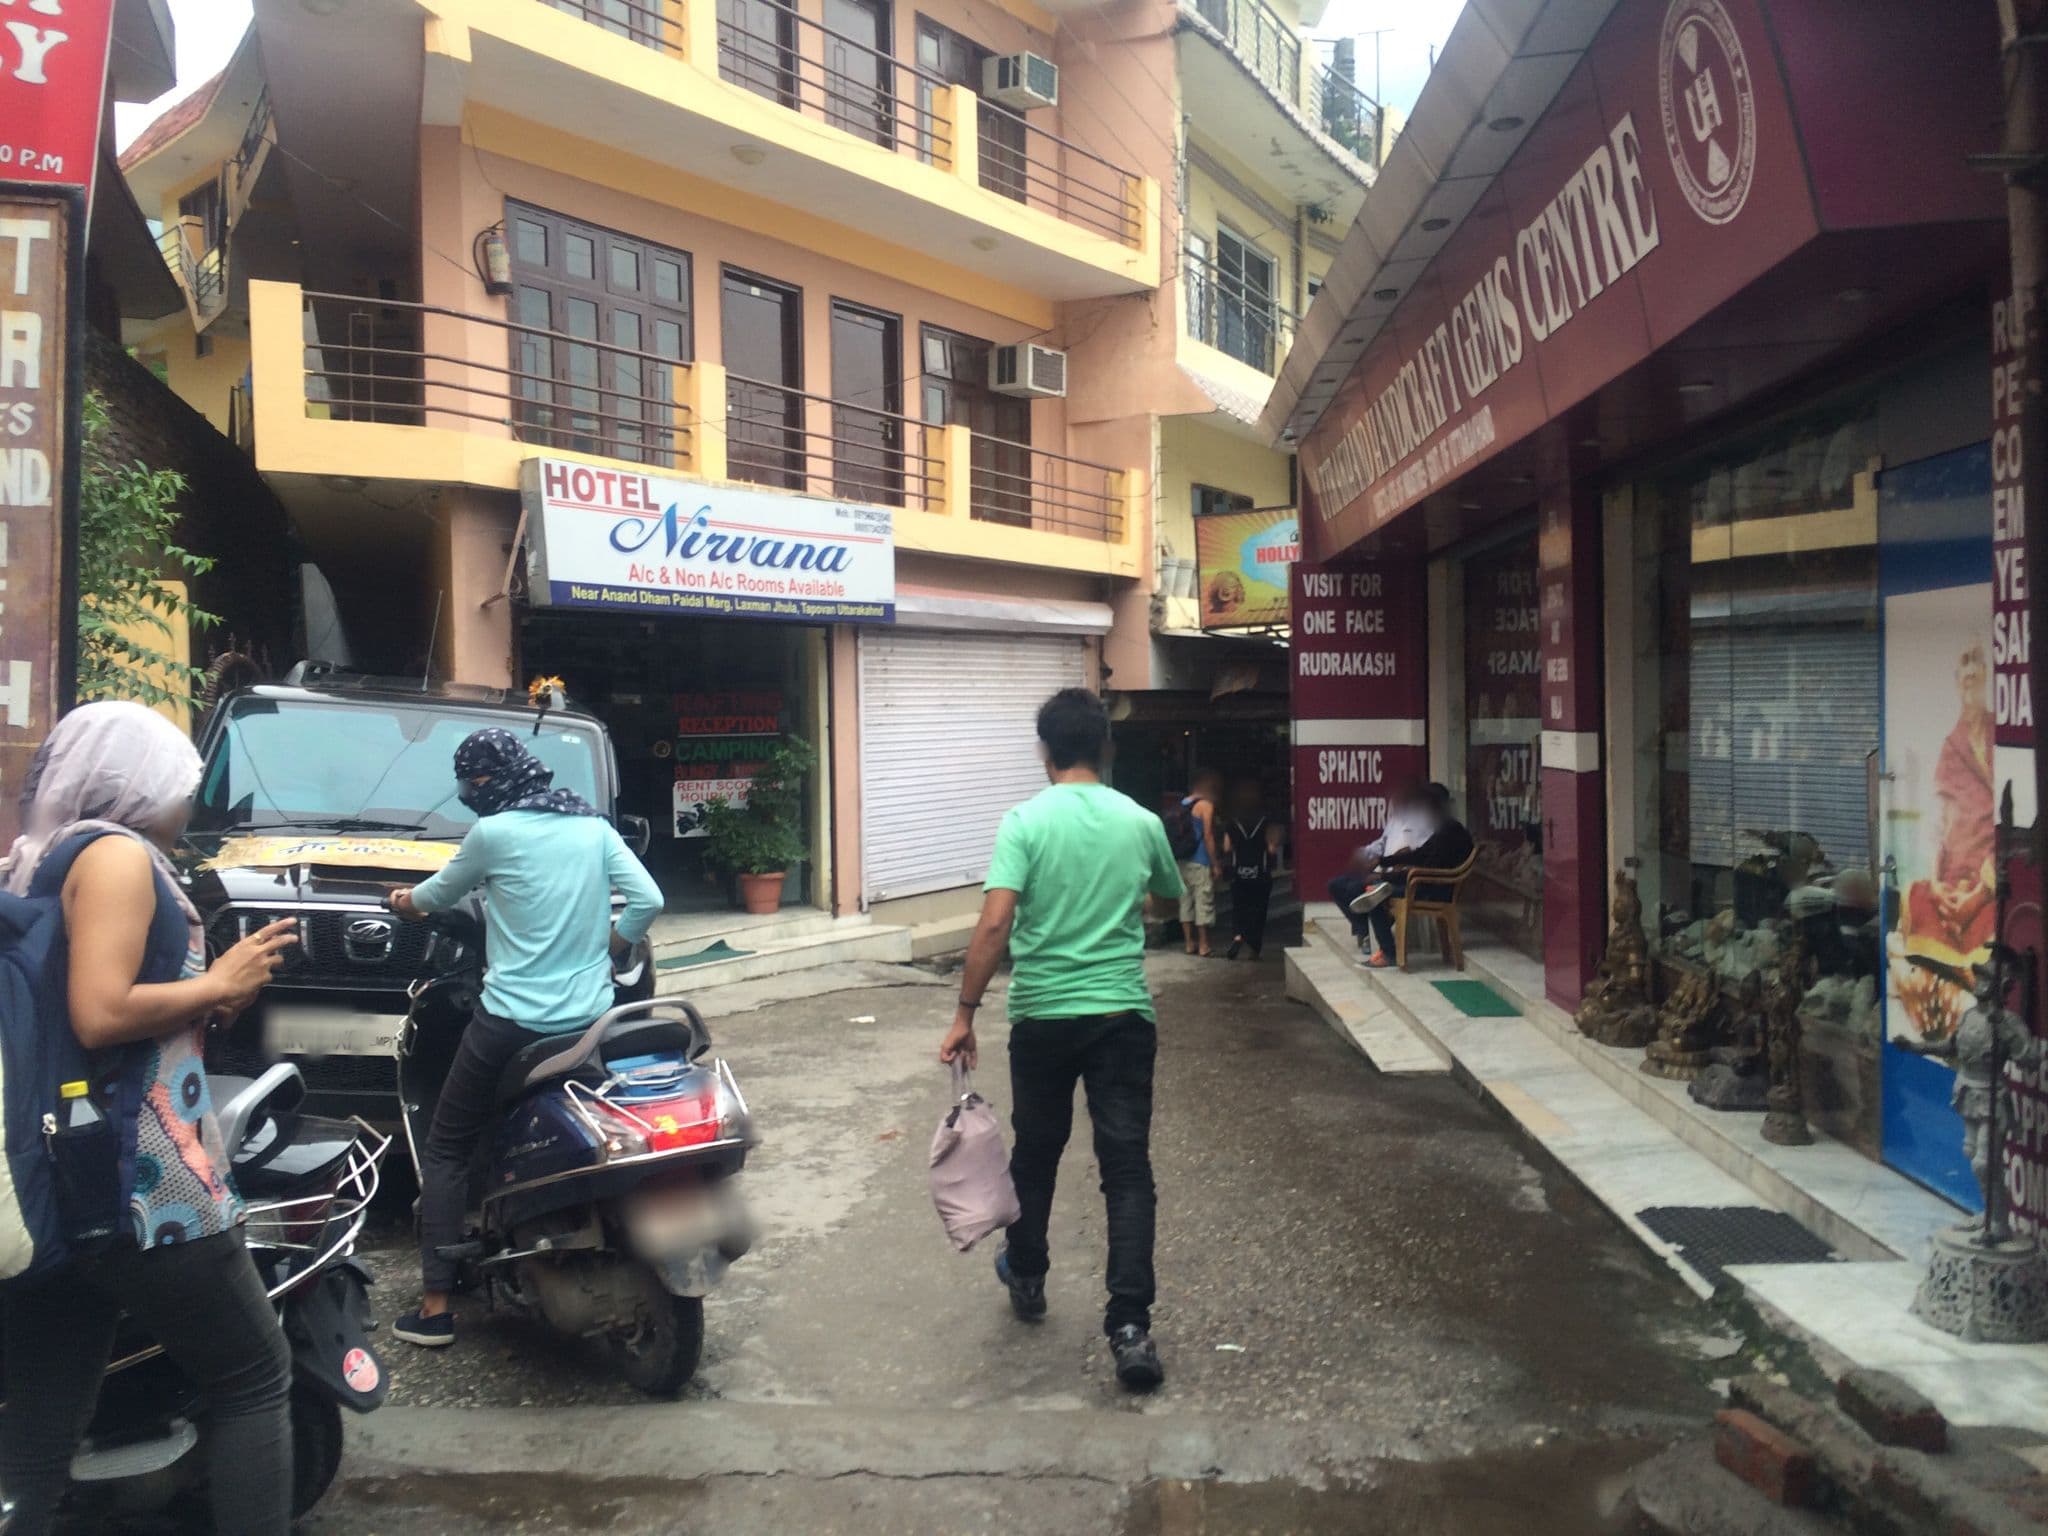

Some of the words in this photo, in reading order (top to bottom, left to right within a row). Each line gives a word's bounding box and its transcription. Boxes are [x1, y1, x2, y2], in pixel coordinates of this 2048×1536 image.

[1452, 256, 1523, 398] GEMS
[1516, 112, 1660, 342] CENTRE
[545, 462, 660, 511] HOTEL
[609, 501, 853, 573] Nirwana
[628, 563, 655, 584] A/c
[659, 566, 671, 585] &
[675, 567, 706, 588] Non
[710, 571, 733, 590] A/c
[737, 573, 785, 594] Rooms
[788, 578, 846, 597] Available
[1303, 573, 1343, 597] VISIT
[1351, 573, 1382, 597] FOR
[571, 585, 599, 600] Near
[602, 588, 637, 603] Anand
[640, 591, 671, 605] Dham
[673, 594, 704, 608] Paidal
[735, 597, 771, 611] Laxman
[801, 602, 836, 617] Tapovan
[1303, 610, 1336, 634] ONE
[1345, 609, 1385, 634] FACE
[1299, 652, 1396, 676] RUDRAKASH
[678, 716, 778, 733] RECEPTION
[1319, 750, 1383, 784] SPHATIC
[677, 781, 712, 792] RENT
